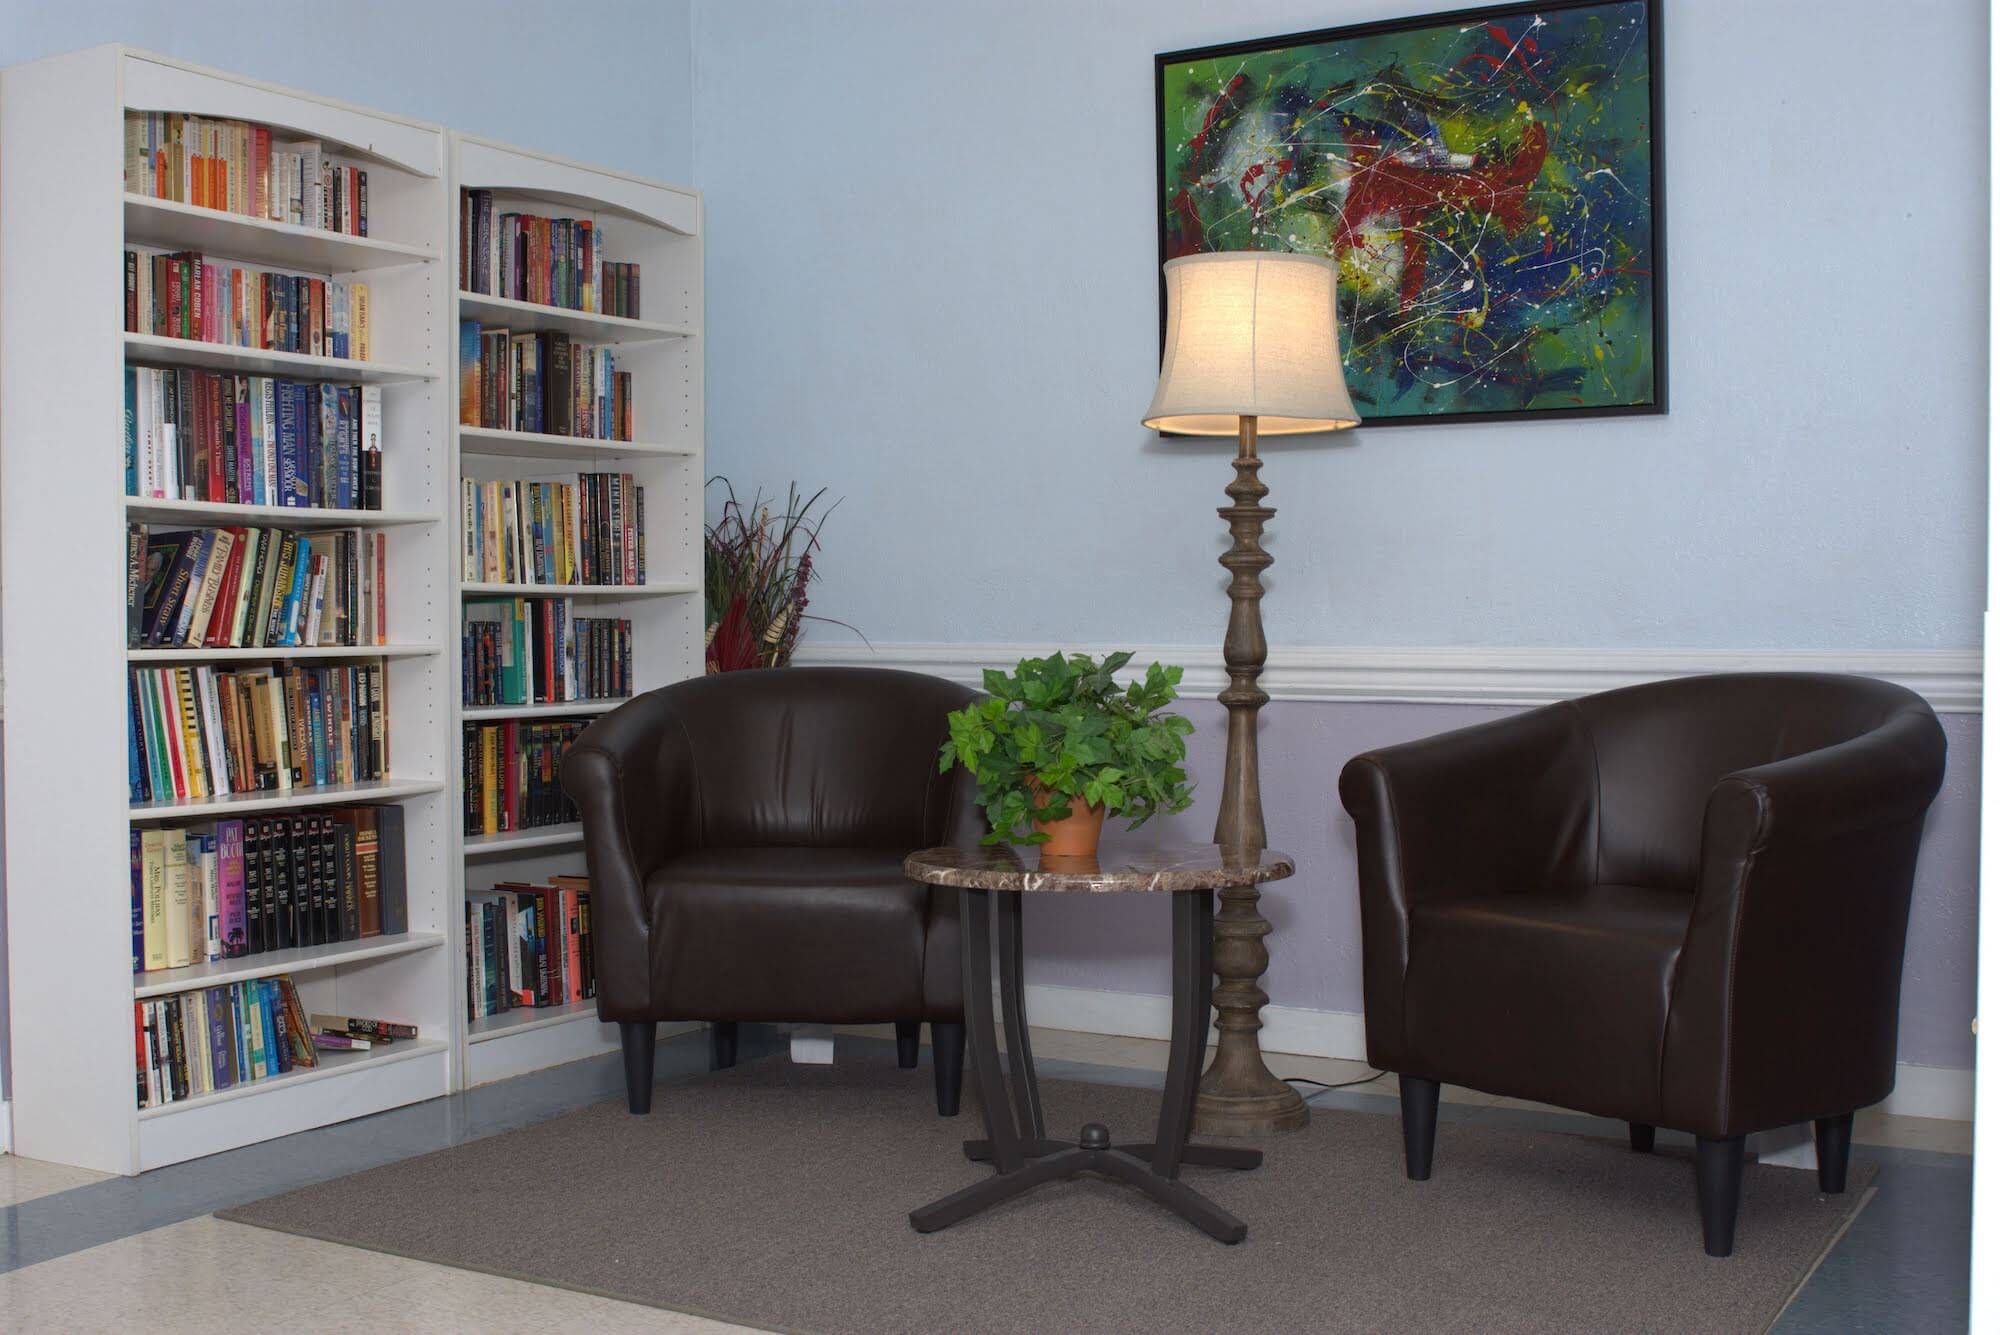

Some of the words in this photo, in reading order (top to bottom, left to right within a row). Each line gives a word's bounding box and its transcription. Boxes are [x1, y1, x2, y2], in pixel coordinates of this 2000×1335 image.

[265, 381, 274, 399] REGIS
[266, 401, 275, 424] PHILBIN
[281, 384, 295, 429] FIGHTING
[282, 432, 295, 455] MAN
[284, 458, 292, 491] SEYMOUR
[129, 533, 140, 558] James
[282, 541, 294, 560] IRIS
[628, 551, 636, 569] MAAS
[211, 545, 229, 577] FAMILY
[128, 569, 138, 608] Michener
[169, 568, 190, 598] Short
[200, 577, 220, 614] BUSINESS
[272, 560, 289, 608] JOHANSEN
[159, 597, 178, 625] Straw
[558, 604, 566, 629] JAMES
[559, 630, 567, 676] PATTERSON
[327, 695, 335, 746] SWINDLE
[226, 826, 238, 844] PAT
